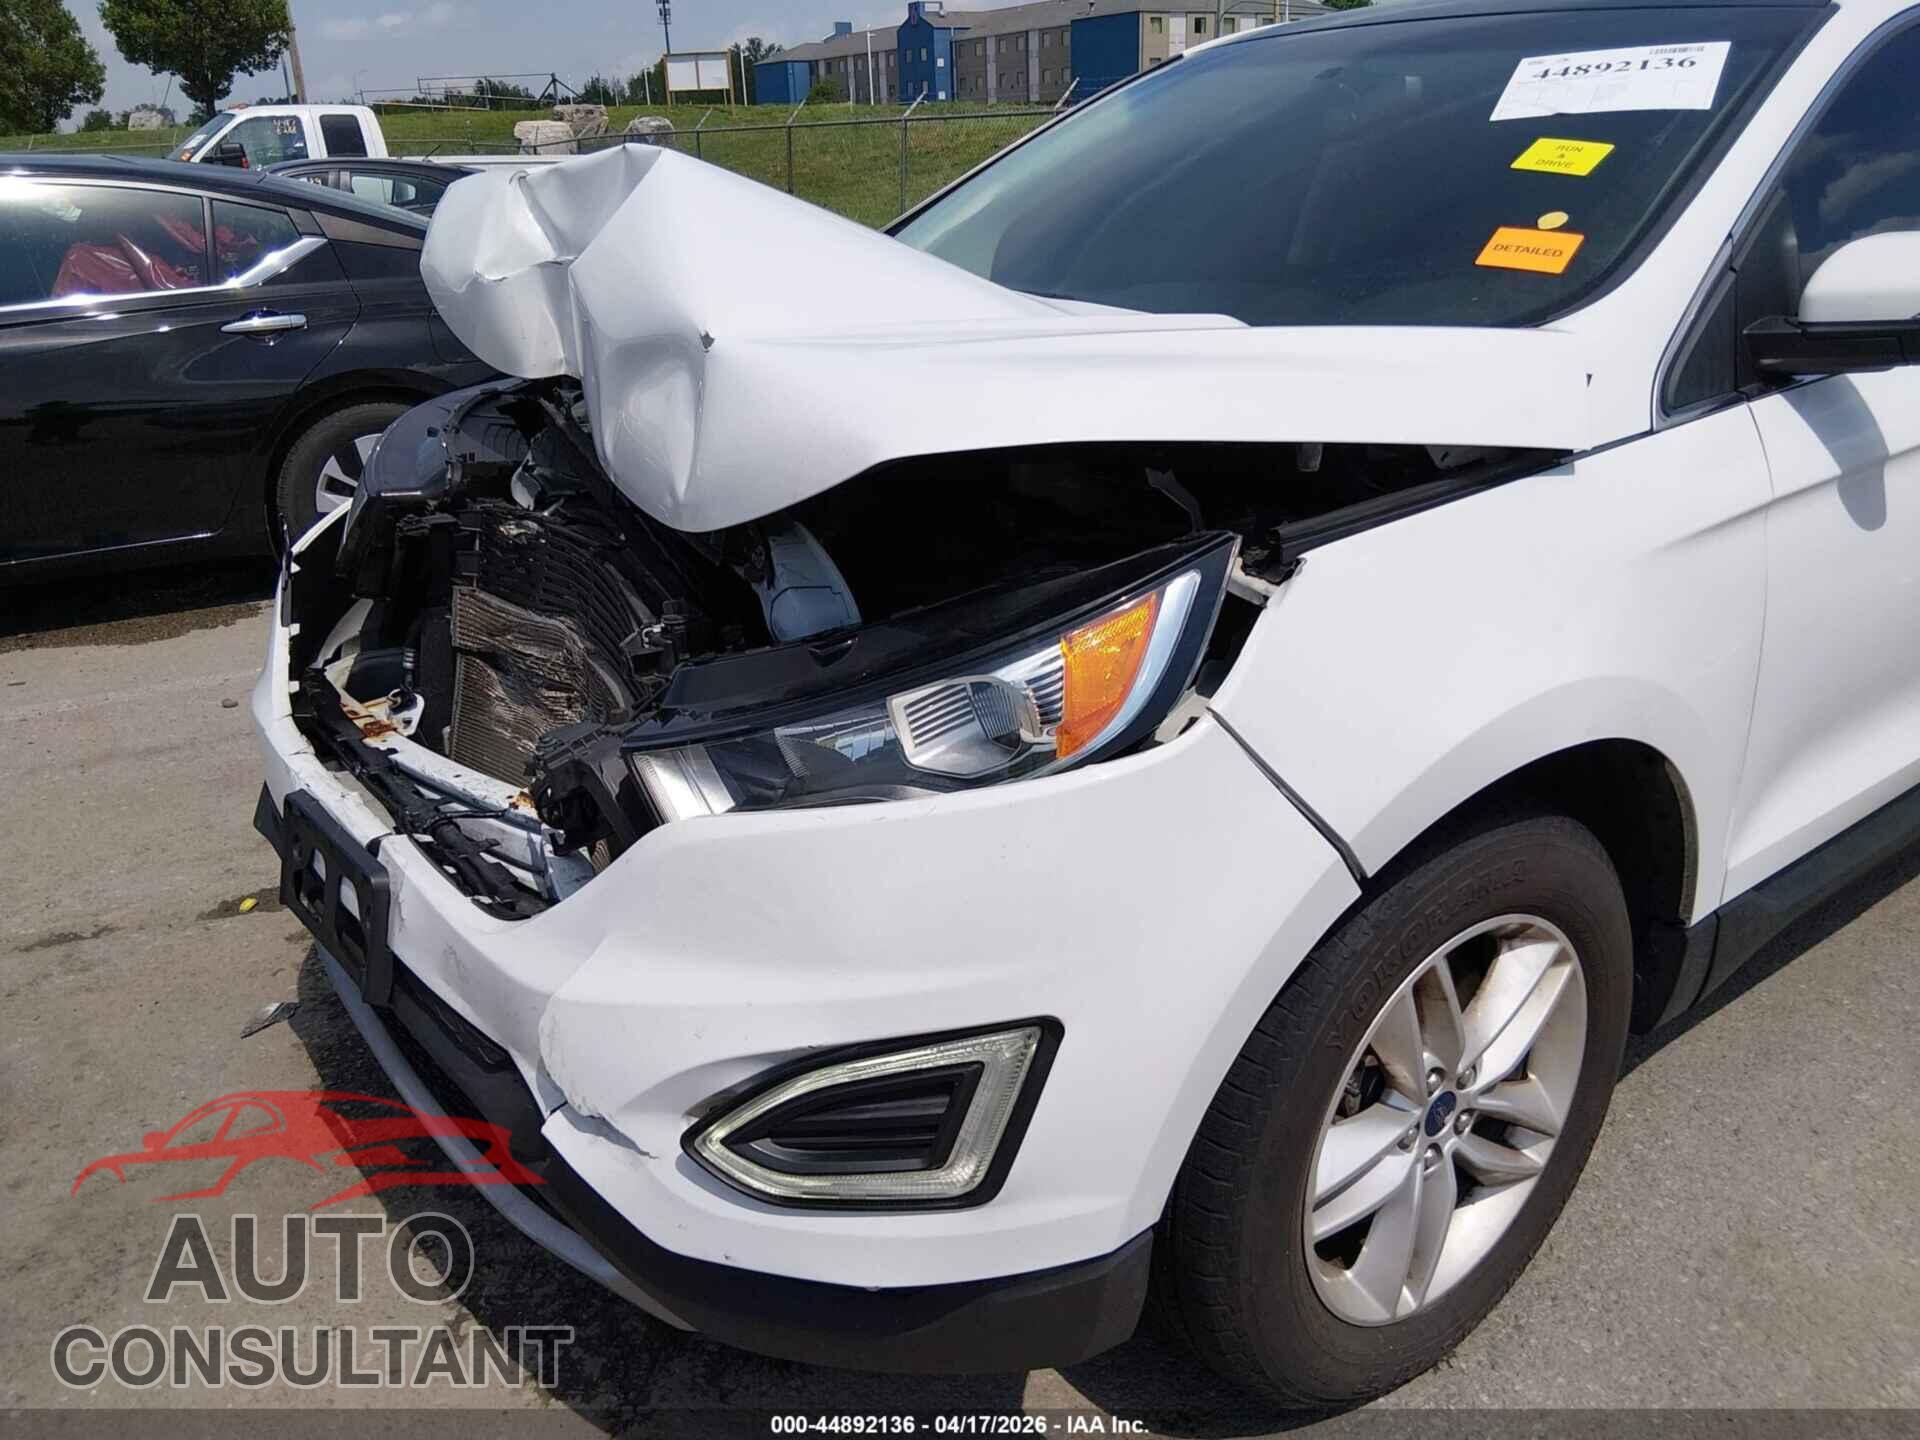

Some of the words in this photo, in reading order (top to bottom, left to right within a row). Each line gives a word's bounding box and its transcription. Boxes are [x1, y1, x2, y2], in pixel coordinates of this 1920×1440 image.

[1532, 56, 1697, 80] 44892136
[1555, 144, 1584, 153] RUN
[1535, 159, 1575, 169] DRIVE
[1493, 243, 1564, 257] DETAILED
